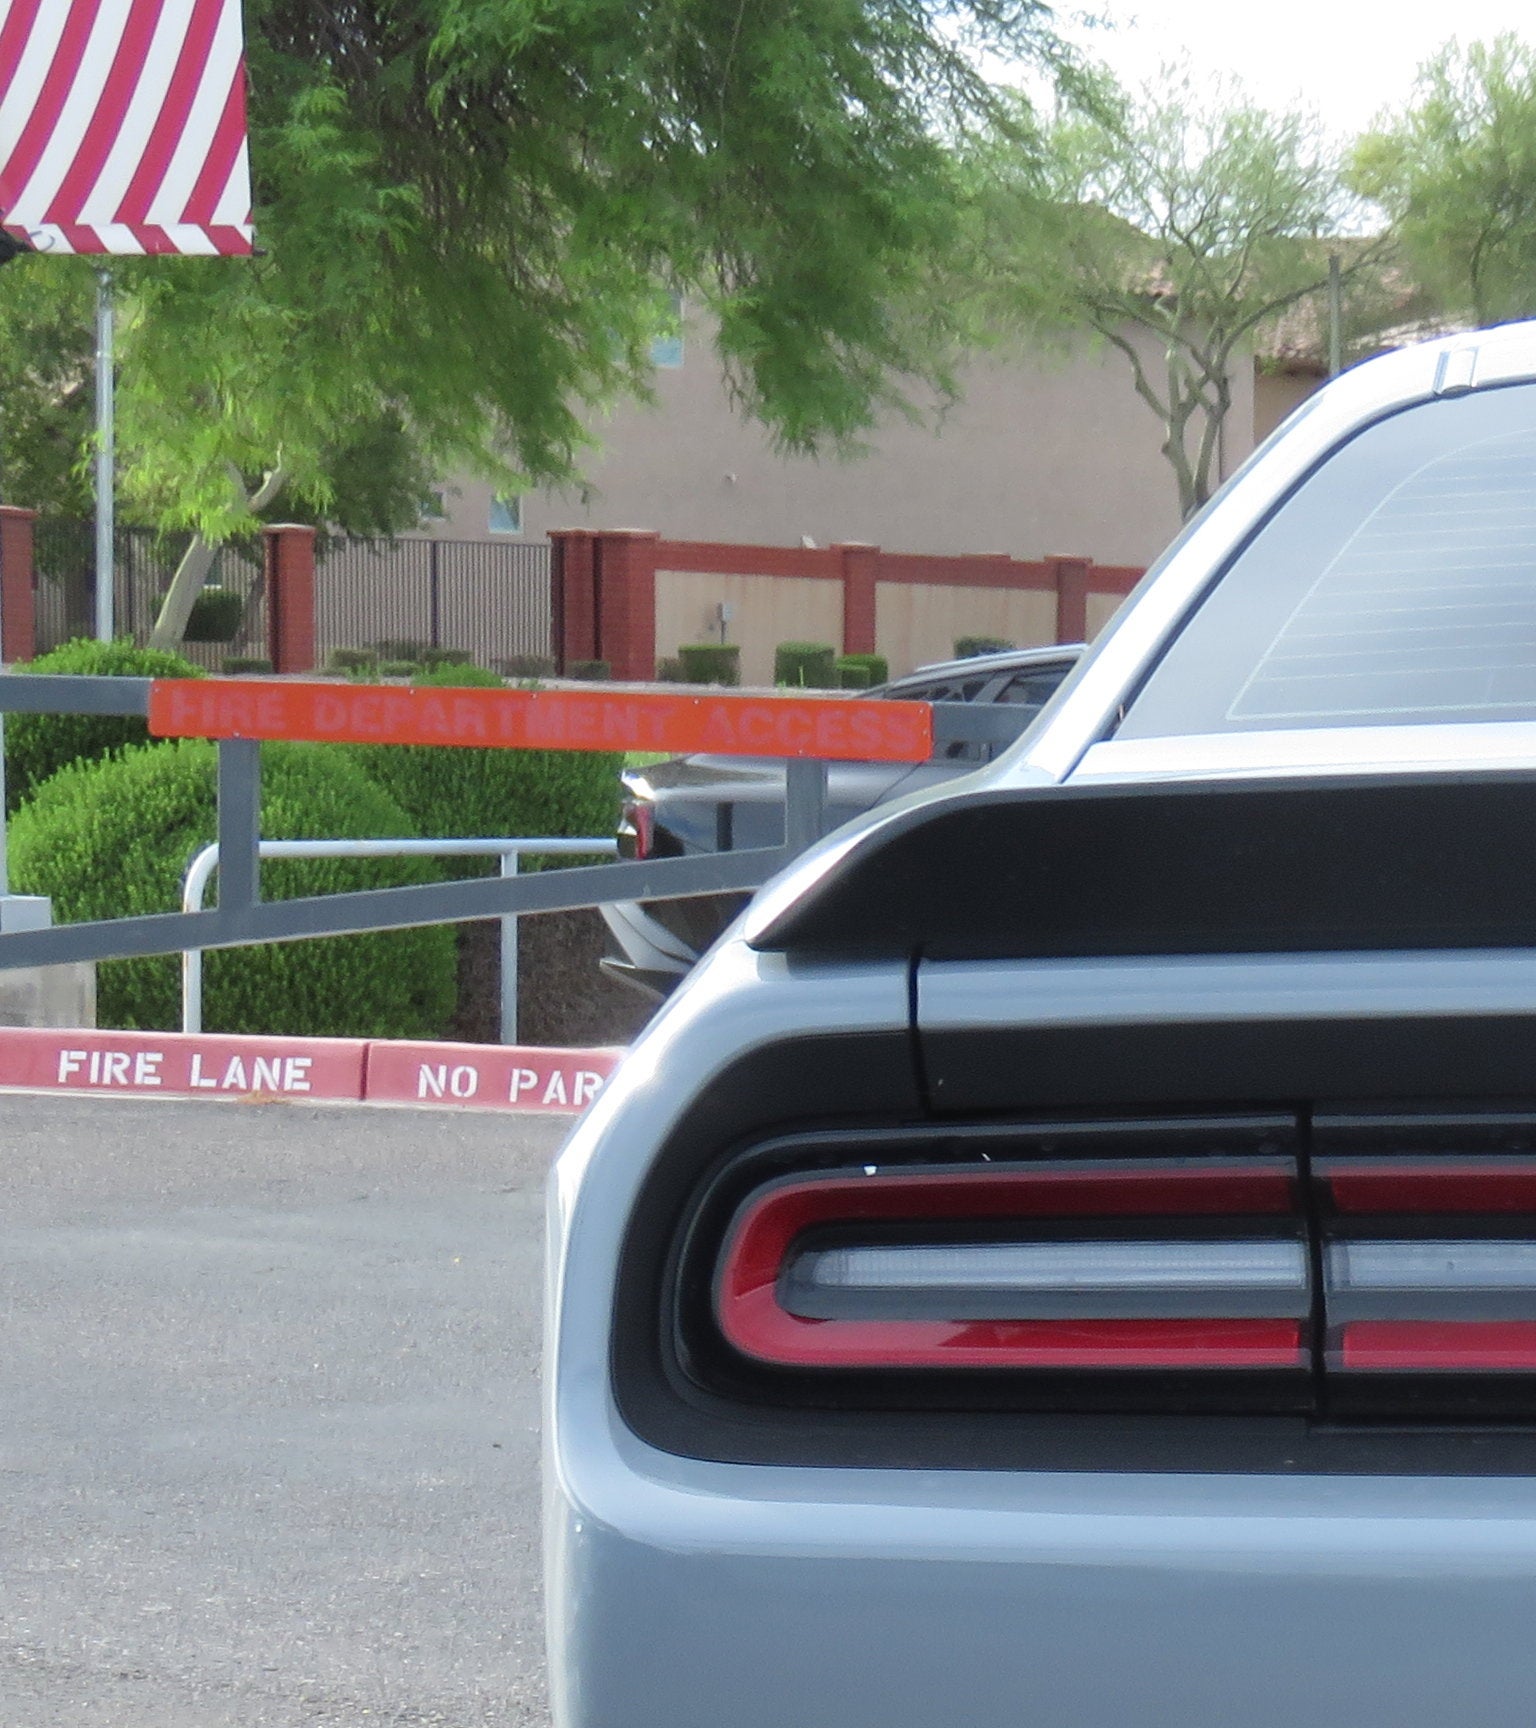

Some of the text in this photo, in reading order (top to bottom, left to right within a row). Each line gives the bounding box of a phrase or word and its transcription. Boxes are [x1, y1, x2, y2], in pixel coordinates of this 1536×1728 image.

[170, 686, 920, 754] FIRE DEPARTMENT ACCESS
[58, 1050, 313, 1091] FIRE LANE
[417, 1064, 479, 1098] NO
